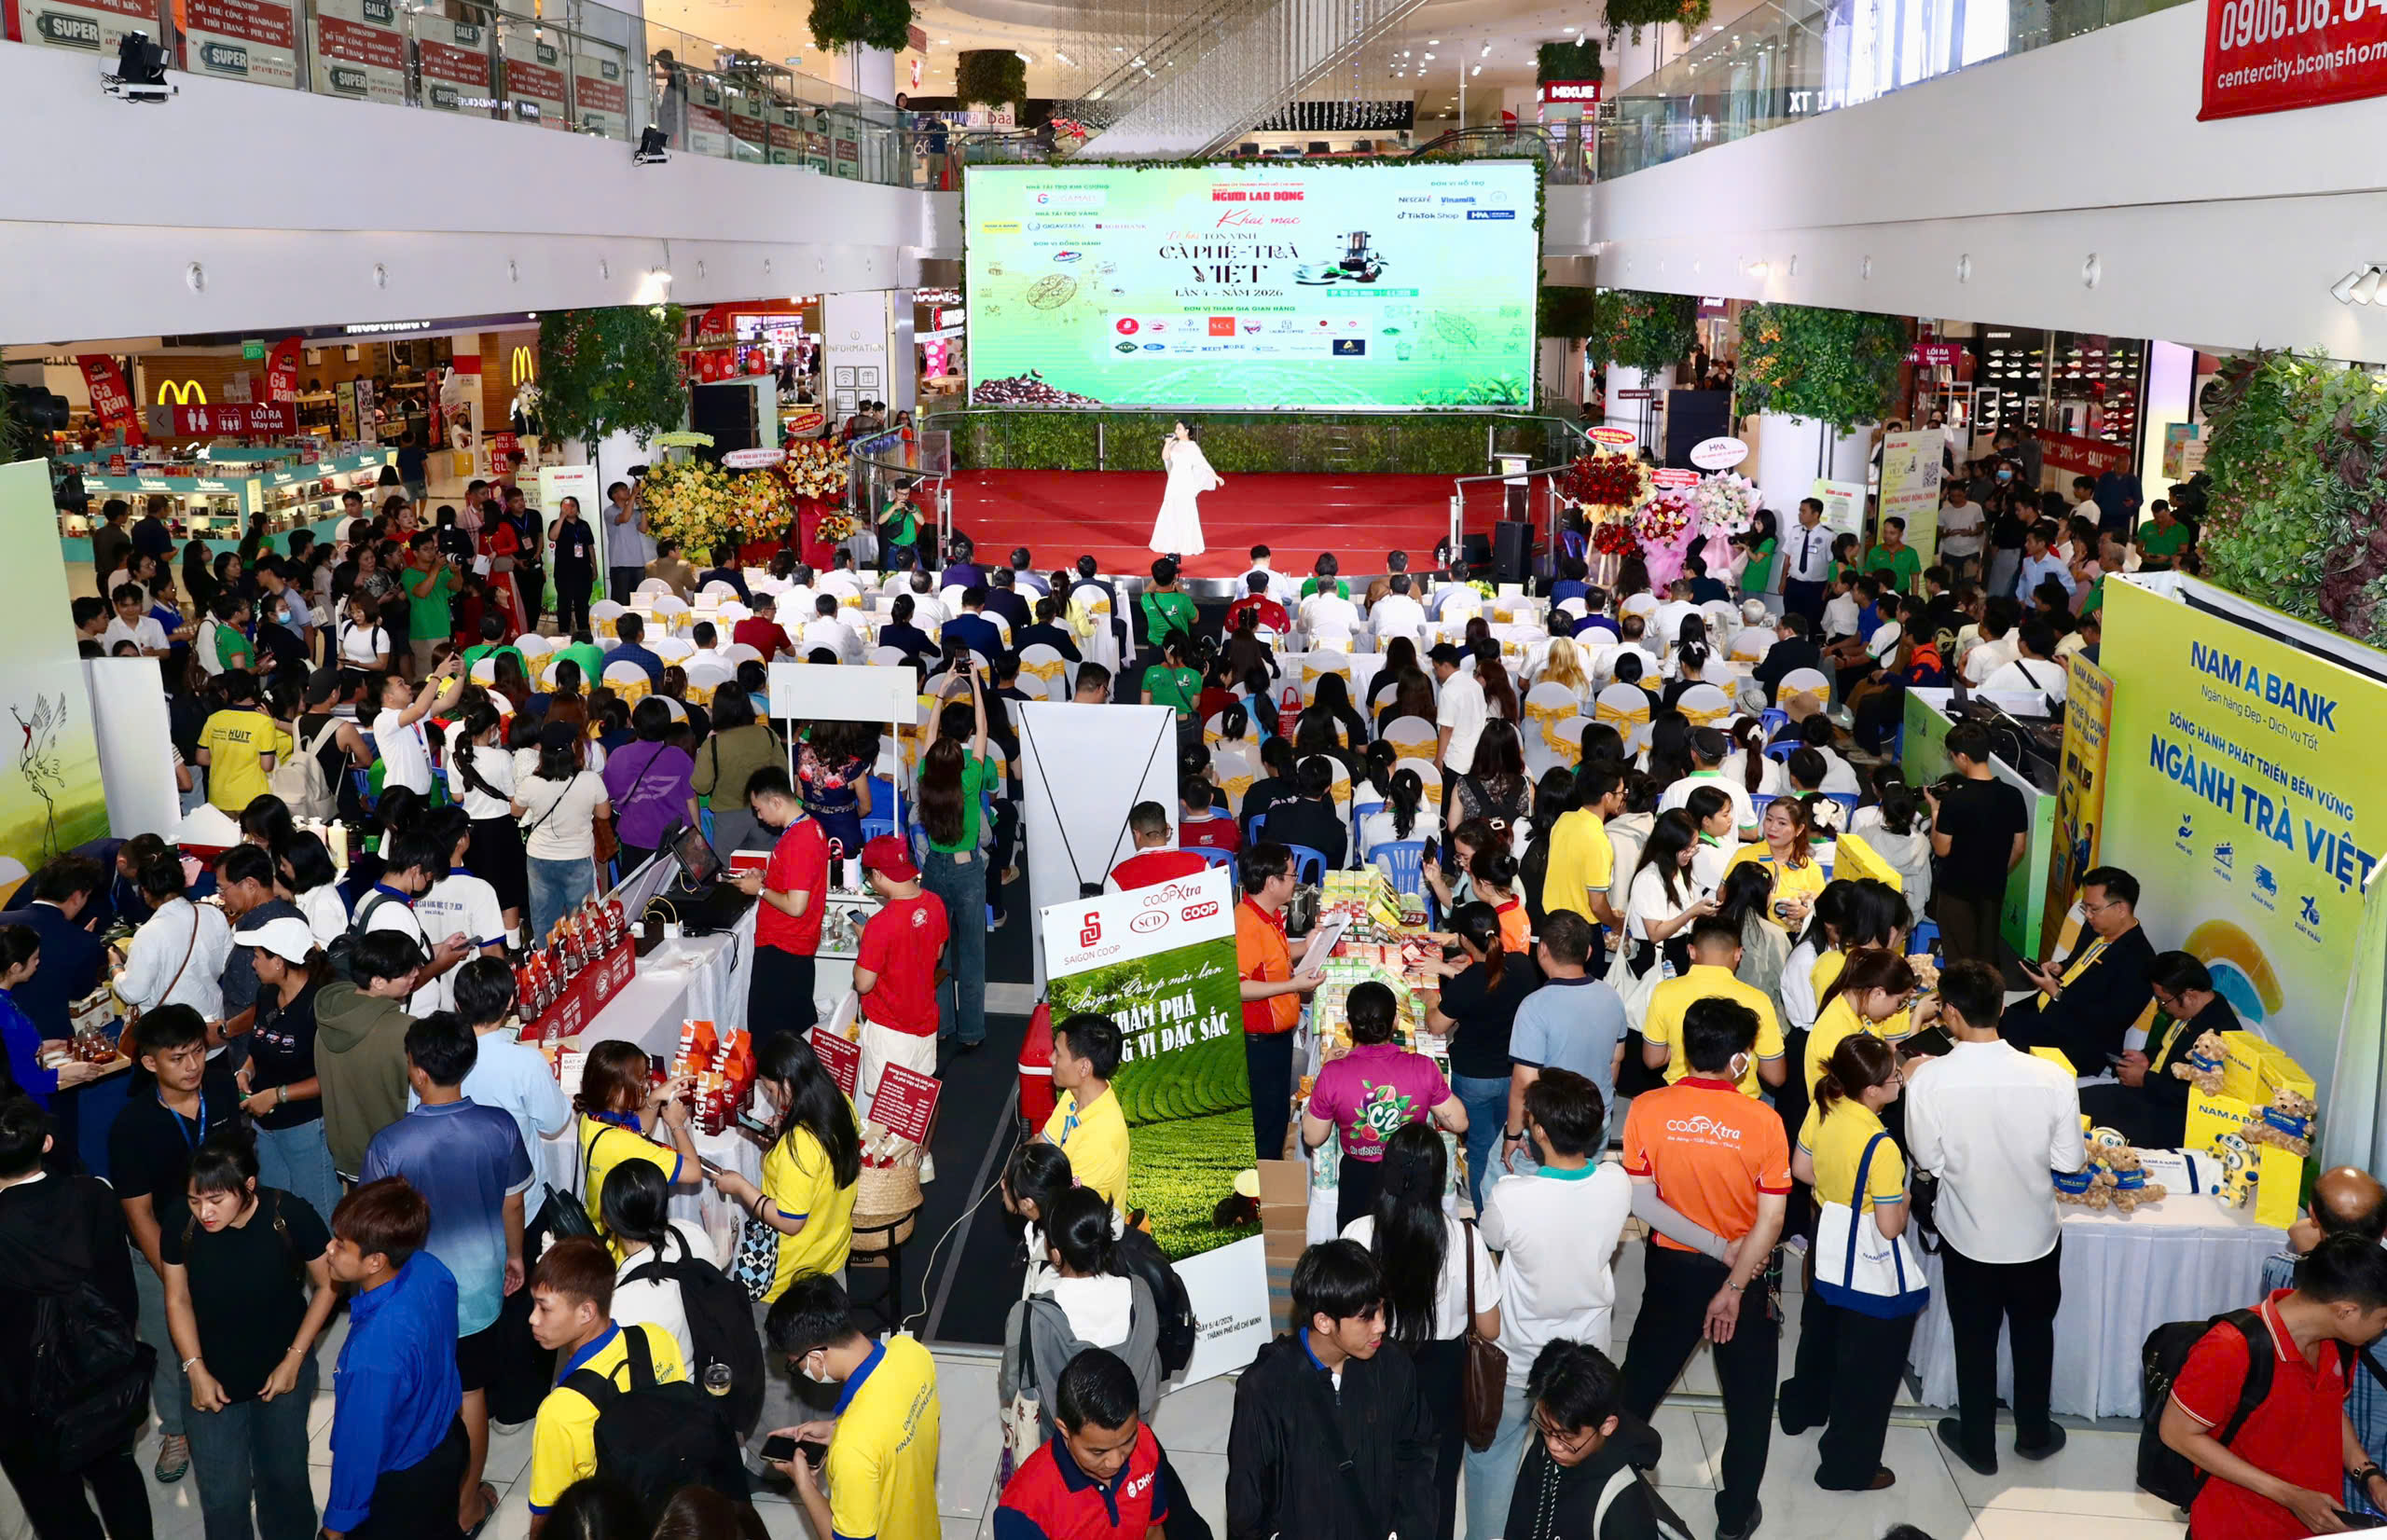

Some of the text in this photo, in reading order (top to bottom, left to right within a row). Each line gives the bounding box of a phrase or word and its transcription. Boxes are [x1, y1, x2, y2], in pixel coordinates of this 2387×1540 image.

[226, 9, 243, 21] CÔNG
[365, 3, 385, 18] SALE
[52, 18, 99, 41] SUPER
[223, 21, 245, 34] TRANG
[347, 25, 377, 38] WORKSHOP
[456, 26, 474, 39] SALE
[212, 47, 247, 66] SUPER
[538, 46, 552, 59] SALE
[602, 63, 615, 76] SALE
[338, 72, 366, 88] SUPER
[436, 89, 458, 103] SUPER
[1552, 85, 1594, 99] MIXUE
[1249, 191, 1270, 201] LAO
[1441, 196, 1477, 204] Vinamilk
[1216, 209, 1301, 228] Khai mạc
[1437, 212, 1459, 220] Shop
[1192, 260, 1268, 287] VIỆT
[1222, 286, 1249, 297] NĂM
[1253, 289, 1283, 297] 2026
[246, 348, 257, 357] EXIT
[826, 342, 886, 352] INFORMATION
[1926, 347, 1939, 355] LỐI
[90, 384, 113, 401] Gà
[272, 387, 296, 402] Rán
[100, 393, 129, 417] Rán
[250, 408, 283, 420] LỐI RA
[252, 420, 269, 430] Way
[2059, 444, 2104, 469] 50% SALE
[493, 462, 506, 472] QL
[2073, 660, 2087, 681] NAM
[2190, 639, 2339, 734] NAM A BANK
[2201, 683, 2320, 753] Ngân hàng Đẹp Dịch vụ Tốt
[228, 728, 252, 740] HUIT
[2169, 710, 2355, 822] ĐỒNG HÀNH PHÁT TRIỂN BỀN VỮNG
[2149, 733, 2378, 896] NGÀNH TRÀ VIỆT
[1182, 901, 1219, 921] COOP
[1137, 913, 1162, 930] SCD
[1063, 949, 1097, 966] SAIGON
[1067, 984, 1122, 1014] Saigon
[1166, 968, 1198, 987] mời
[1197, 959, 1225, 981] bạn
[1110, 987, 1198, 1036] HÁM PHÁ
[1120, 1005, 1231, 1065] G VỊ ĐẶC SẮC
[1369, 1105, 1400, 1132] C2
[2199, 1104, 2240, 1122] NAM A
[1862, 1252, 1880, 1260] NAM
[1207, 1314, 1234, 1330] 5/4/2026
[1207, 1315, 1262, 1341] THÀNH PHỐ HỒ CHÍ MINH
